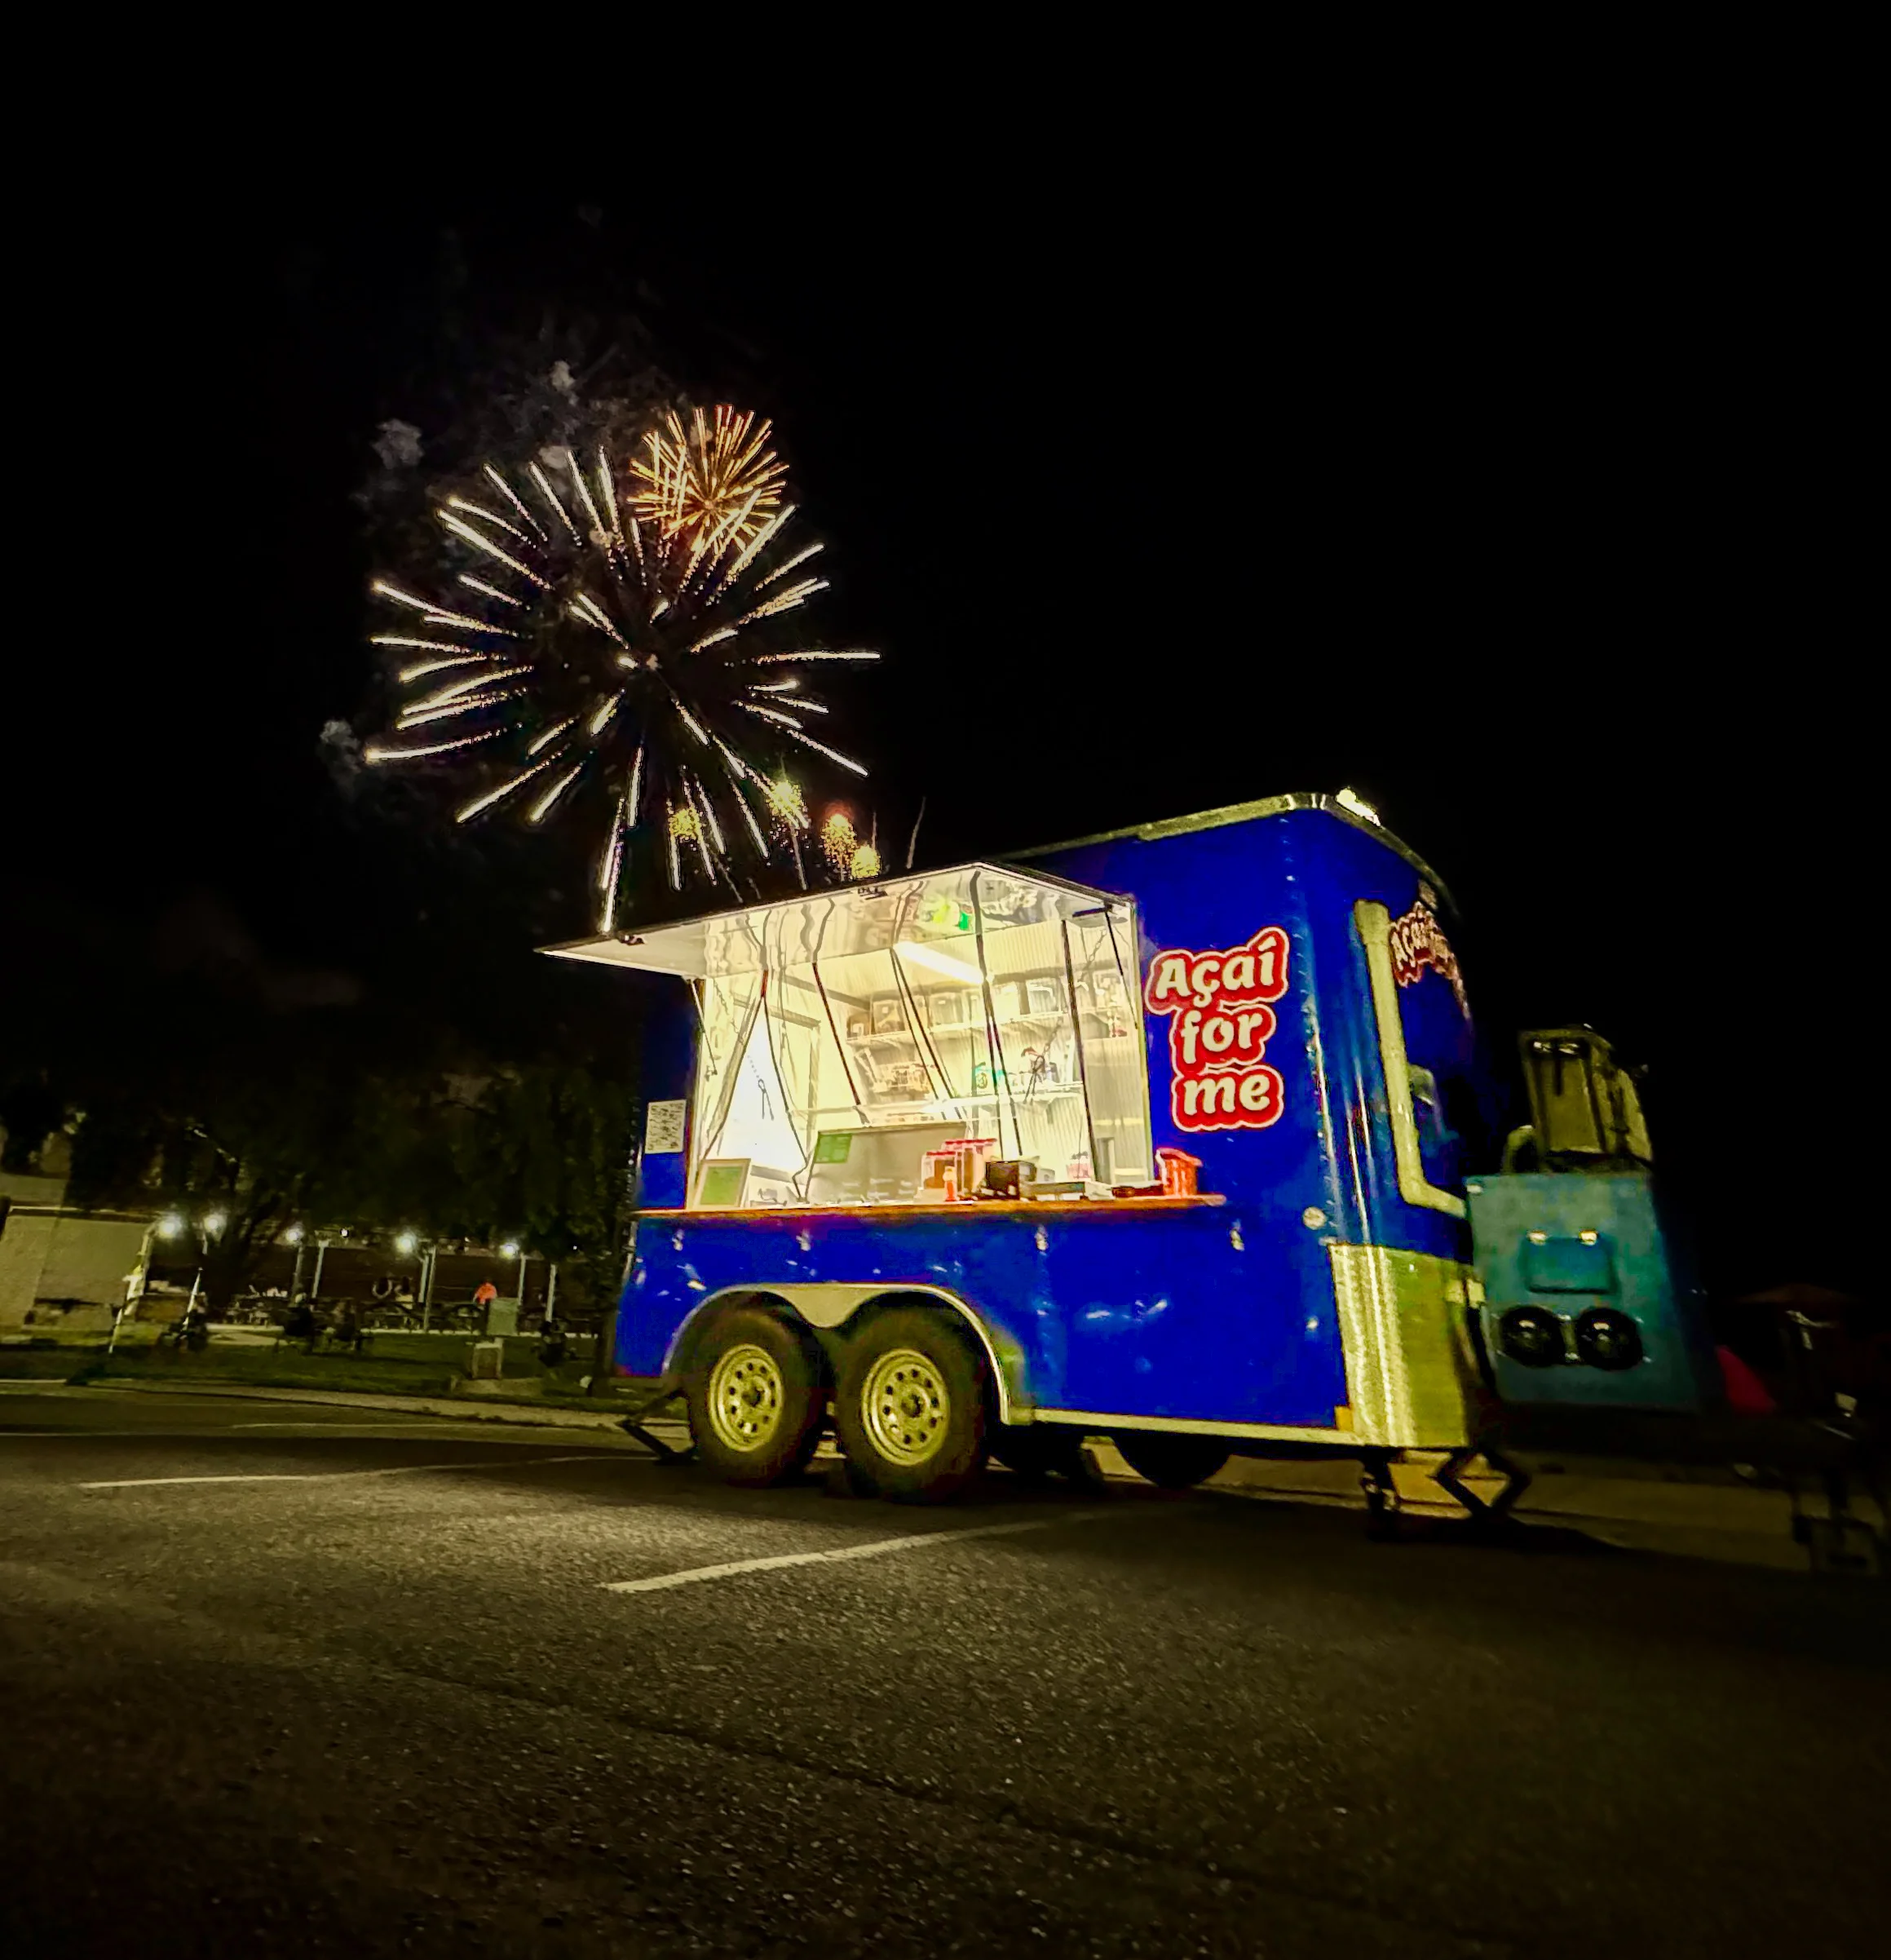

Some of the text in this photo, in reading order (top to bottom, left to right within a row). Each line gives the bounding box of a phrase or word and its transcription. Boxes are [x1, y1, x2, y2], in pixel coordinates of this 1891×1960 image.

[1155, 936, 1276, 1007] Açaí
[1180, 1010, 1263, 1064] for
[1182, 1073, 1271, 1117] me
